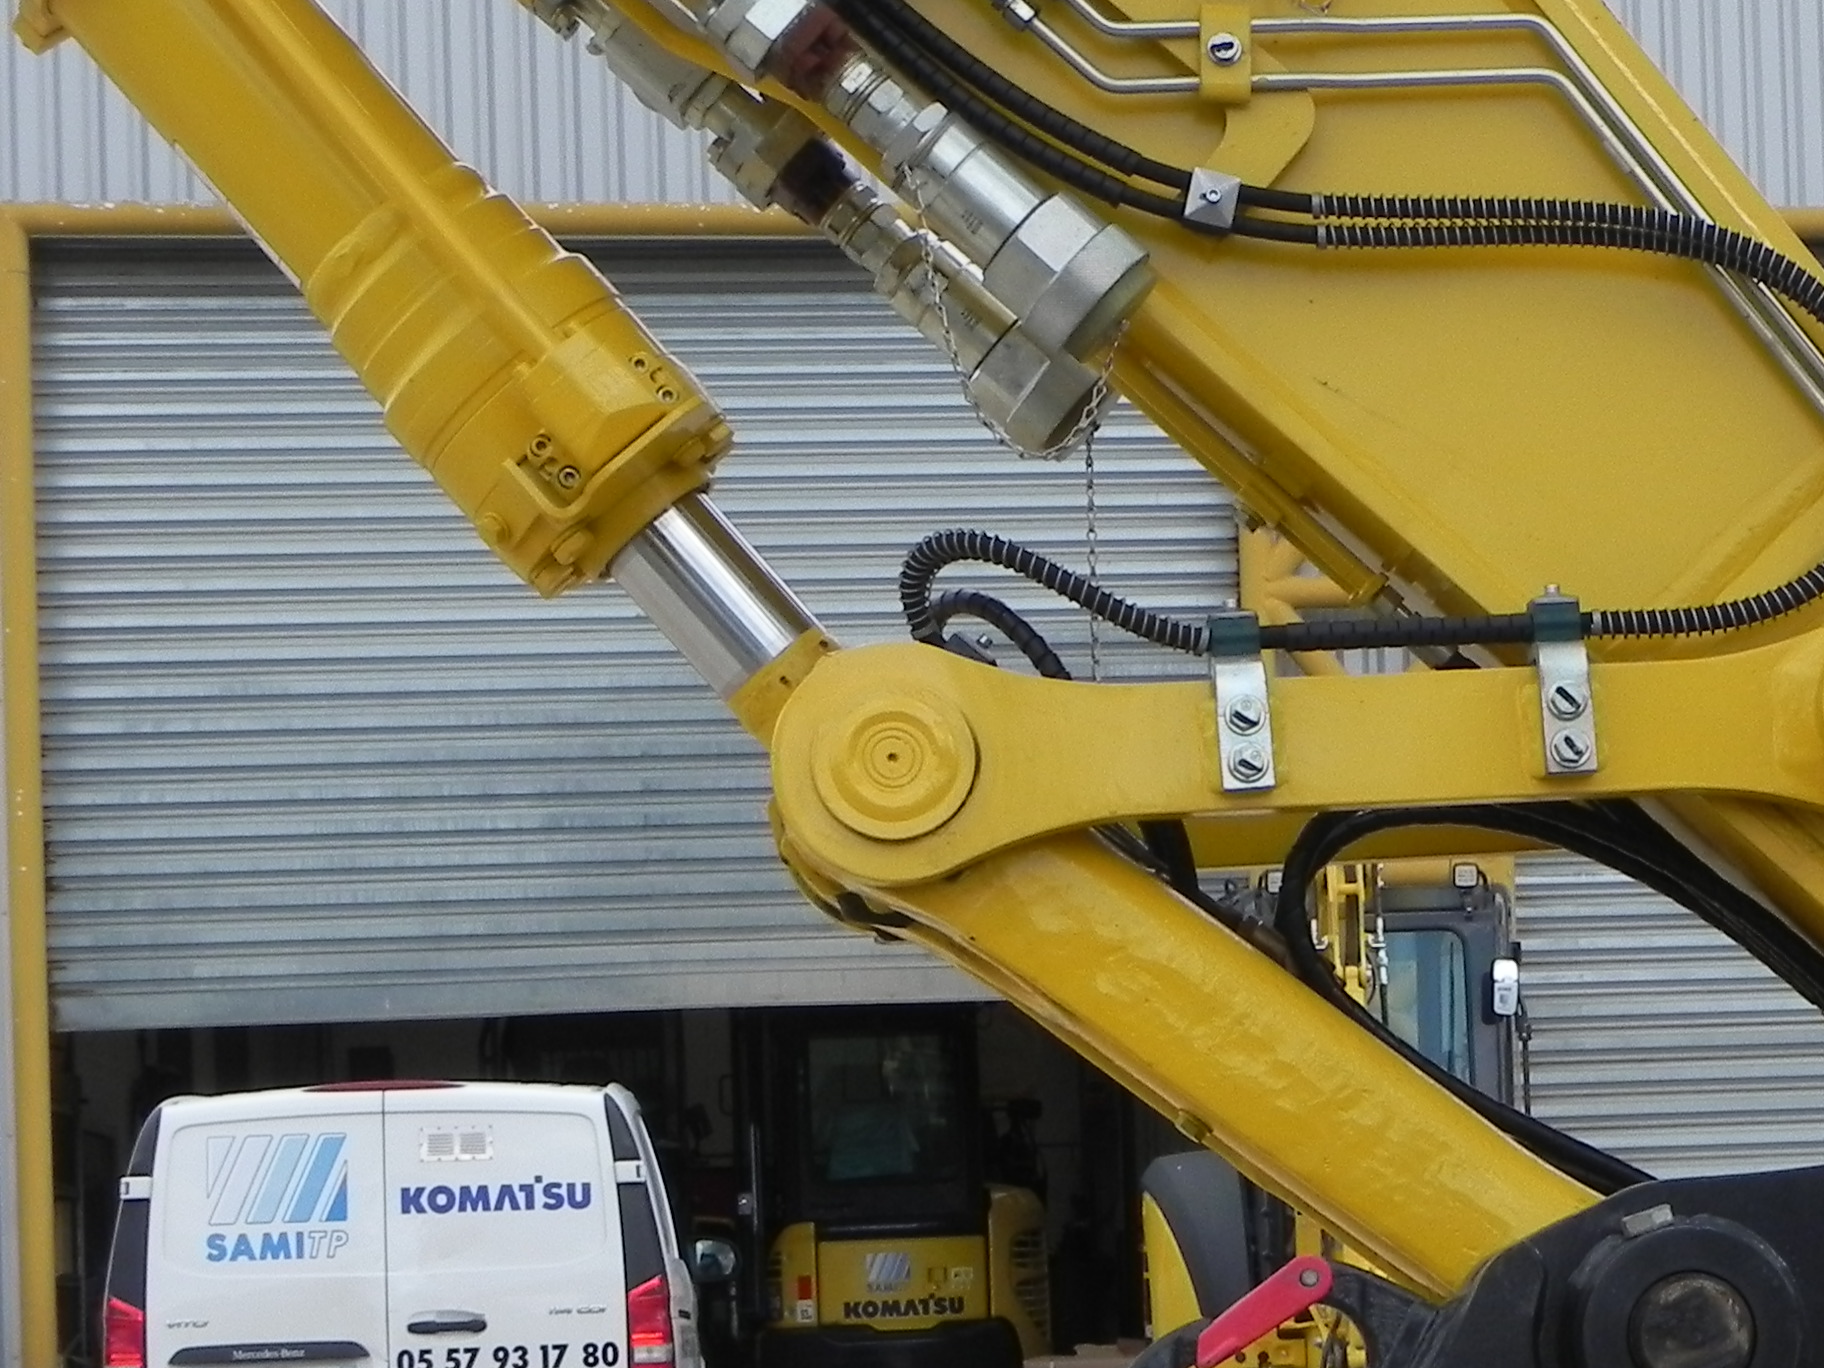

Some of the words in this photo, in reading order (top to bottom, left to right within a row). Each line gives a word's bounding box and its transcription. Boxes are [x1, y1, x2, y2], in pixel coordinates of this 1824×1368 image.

[400, 1175, 592, 1215] KOMATSU
[843, 1293, 965, 1319] KOMATSU
[582, 1341, 620, 1368] 80
